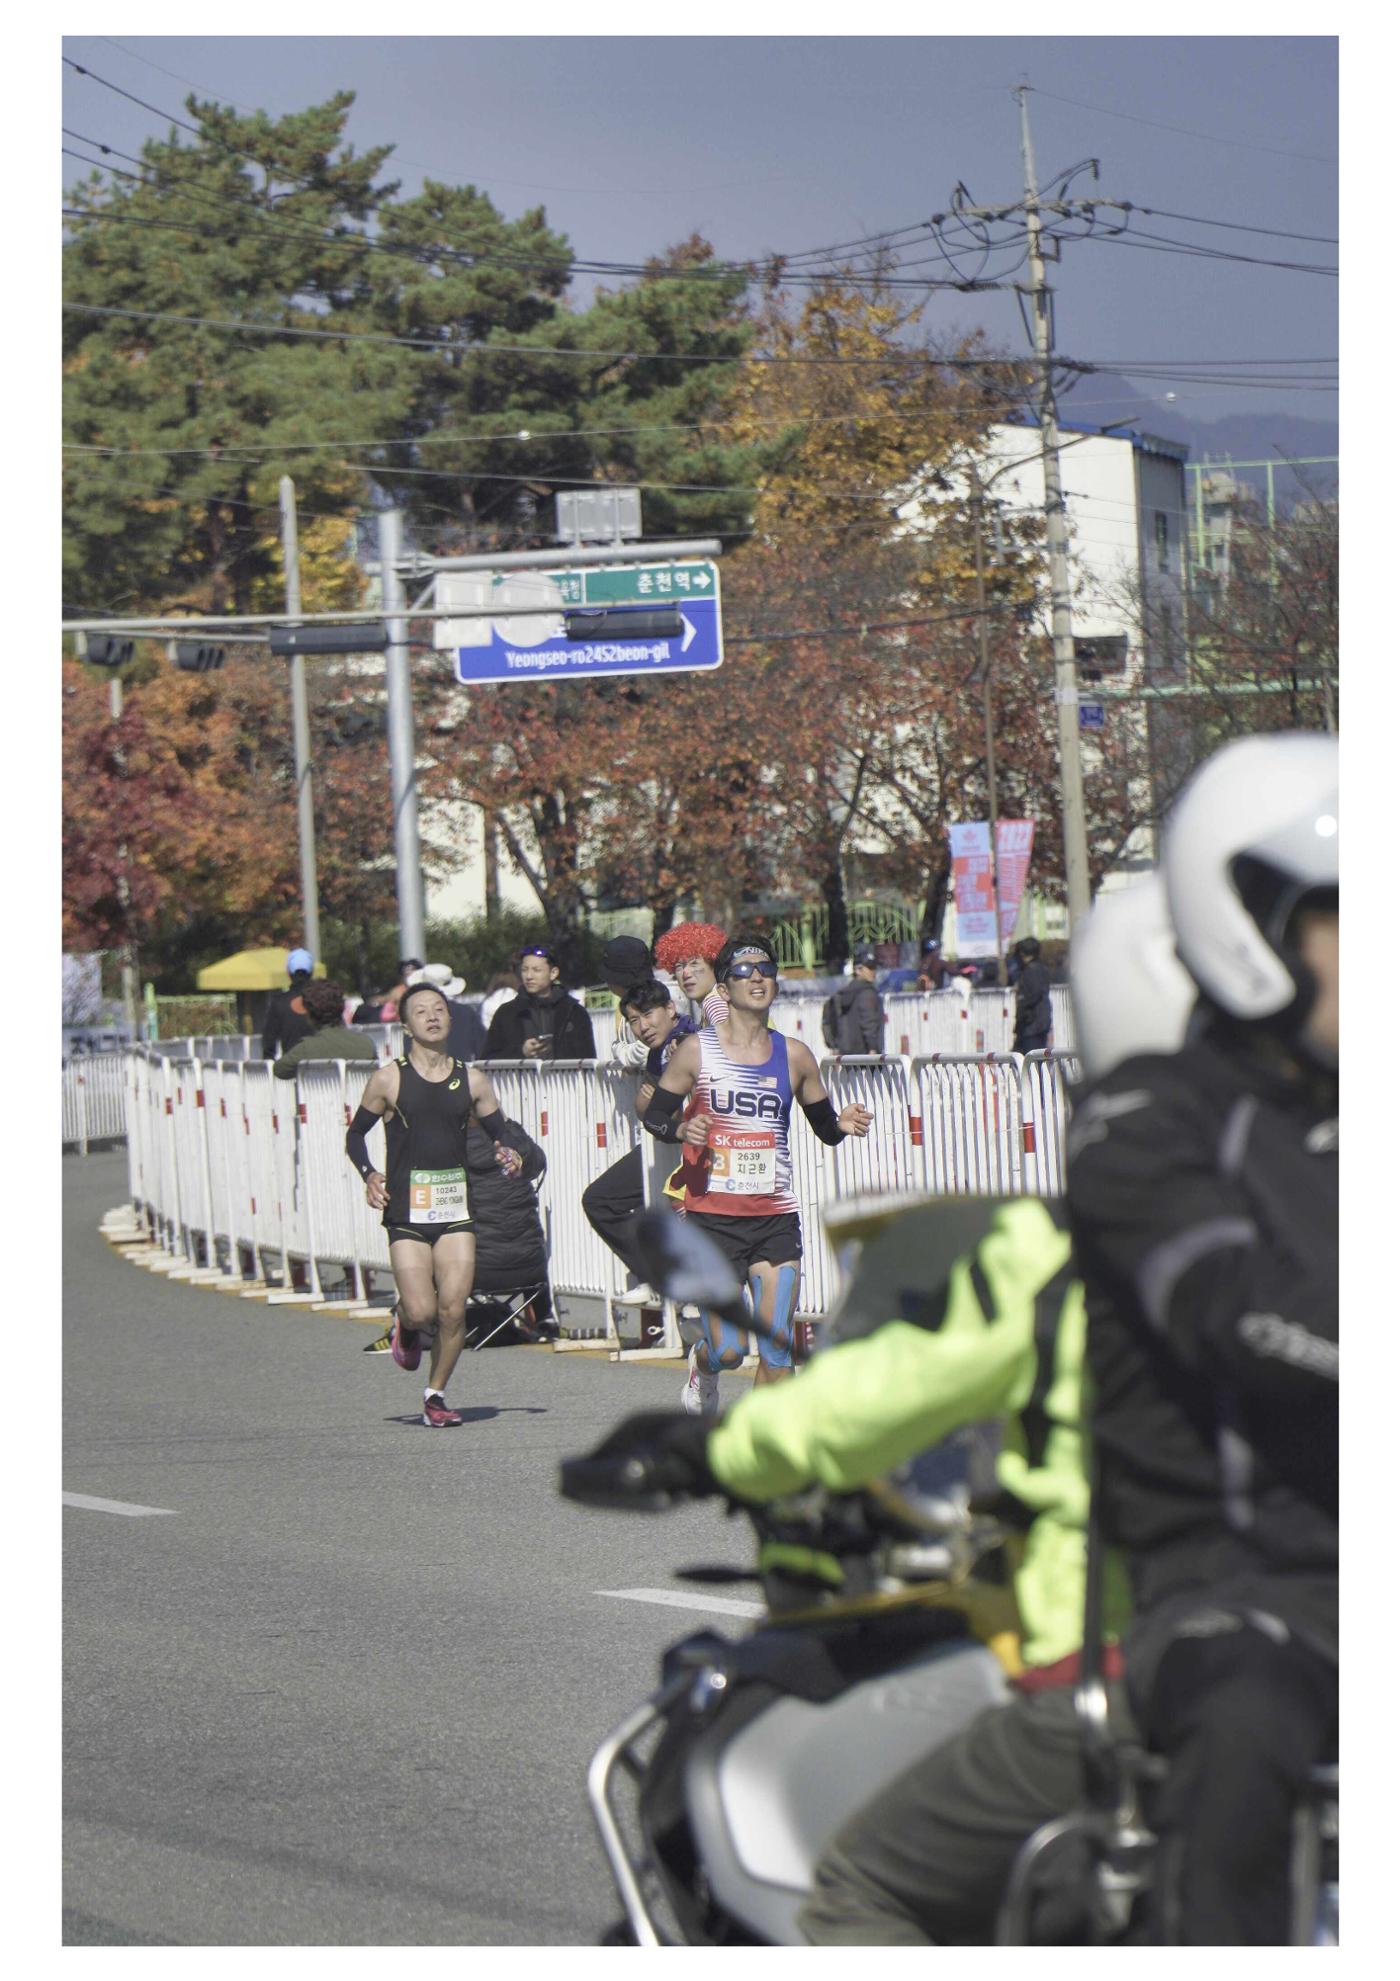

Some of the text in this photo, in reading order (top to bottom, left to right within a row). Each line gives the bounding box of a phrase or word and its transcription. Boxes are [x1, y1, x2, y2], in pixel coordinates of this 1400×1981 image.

[638, 571, 690, 593] 춘천역
[710, 1088, 782, 1119] USA
[715, 1135, 770, 1148] SK telecom
[737, 1152, 761, 1161] 2639
[416, 1189, 426, 1204] E
